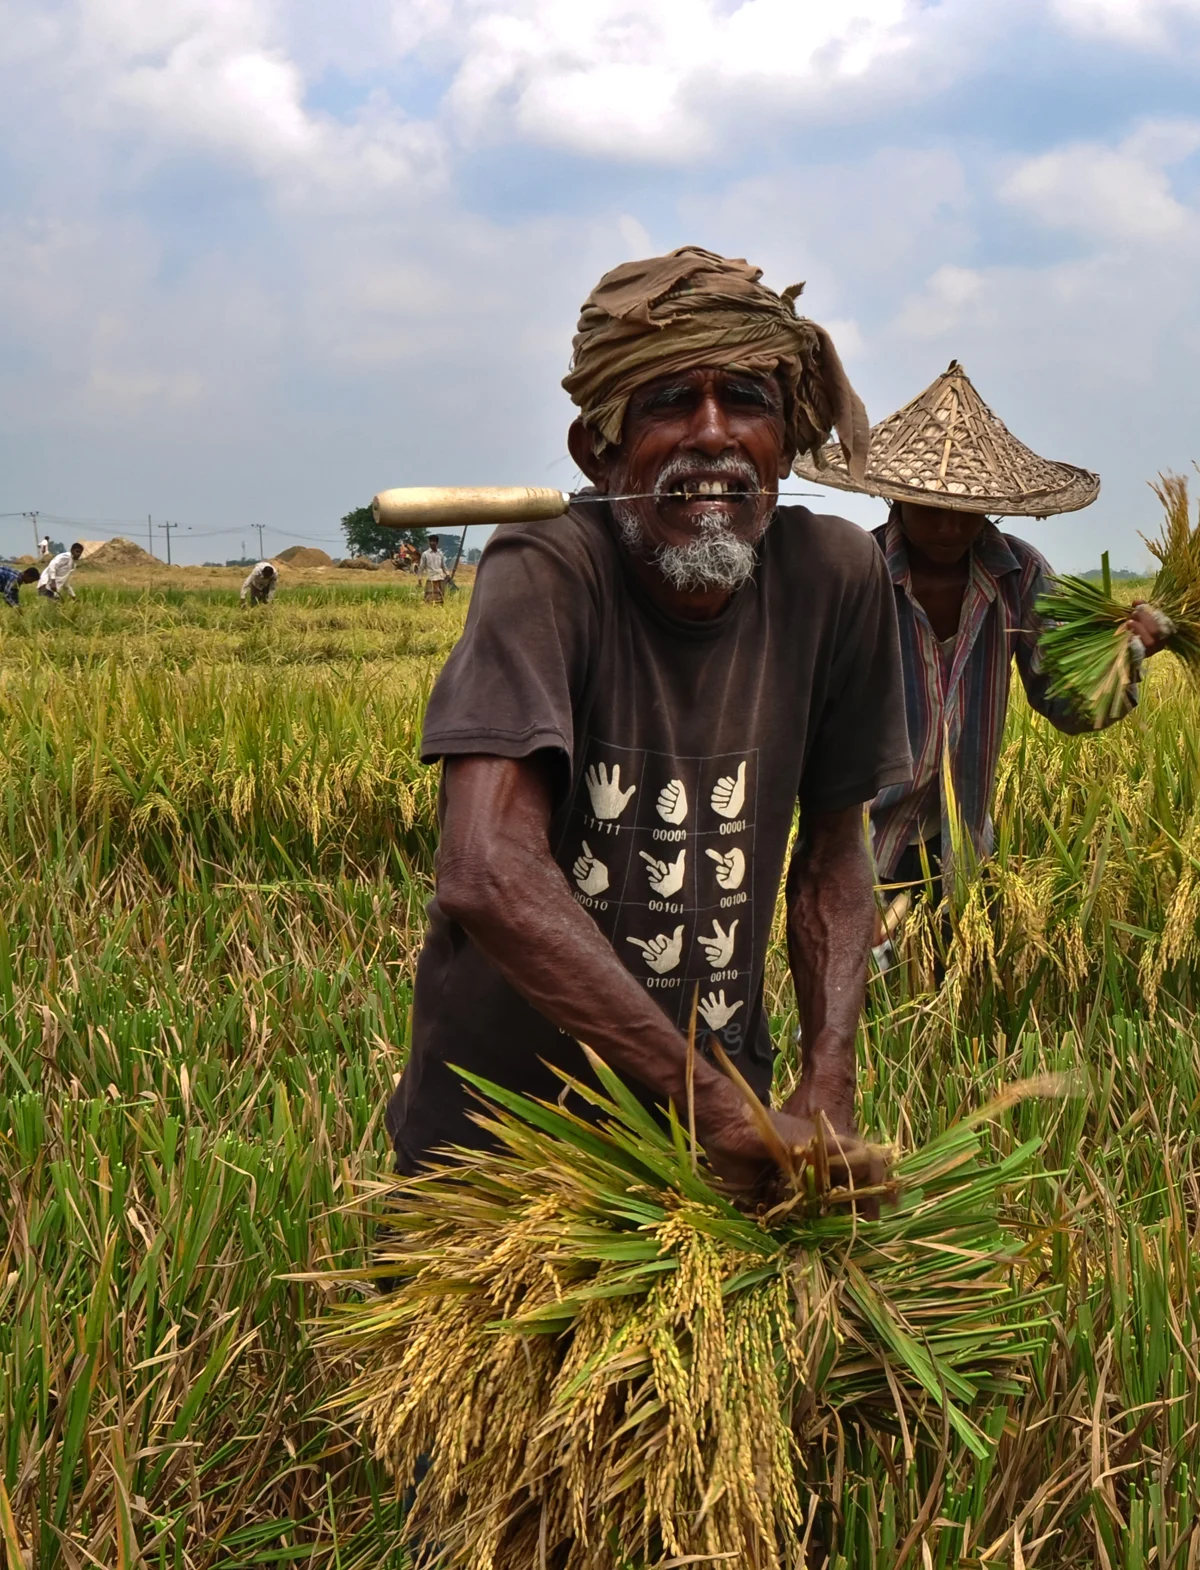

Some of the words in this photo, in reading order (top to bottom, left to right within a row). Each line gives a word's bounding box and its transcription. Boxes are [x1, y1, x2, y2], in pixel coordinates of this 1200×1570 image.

[584, 814, 621, 836] 11111
[719, 819, 746, 835] 00001
[648, 899, 684, 914] 00101
[719, 892, 747, 908] 00100
[646, 977, 681, 988] 01001
[710, 969, 738, 983] 00110
